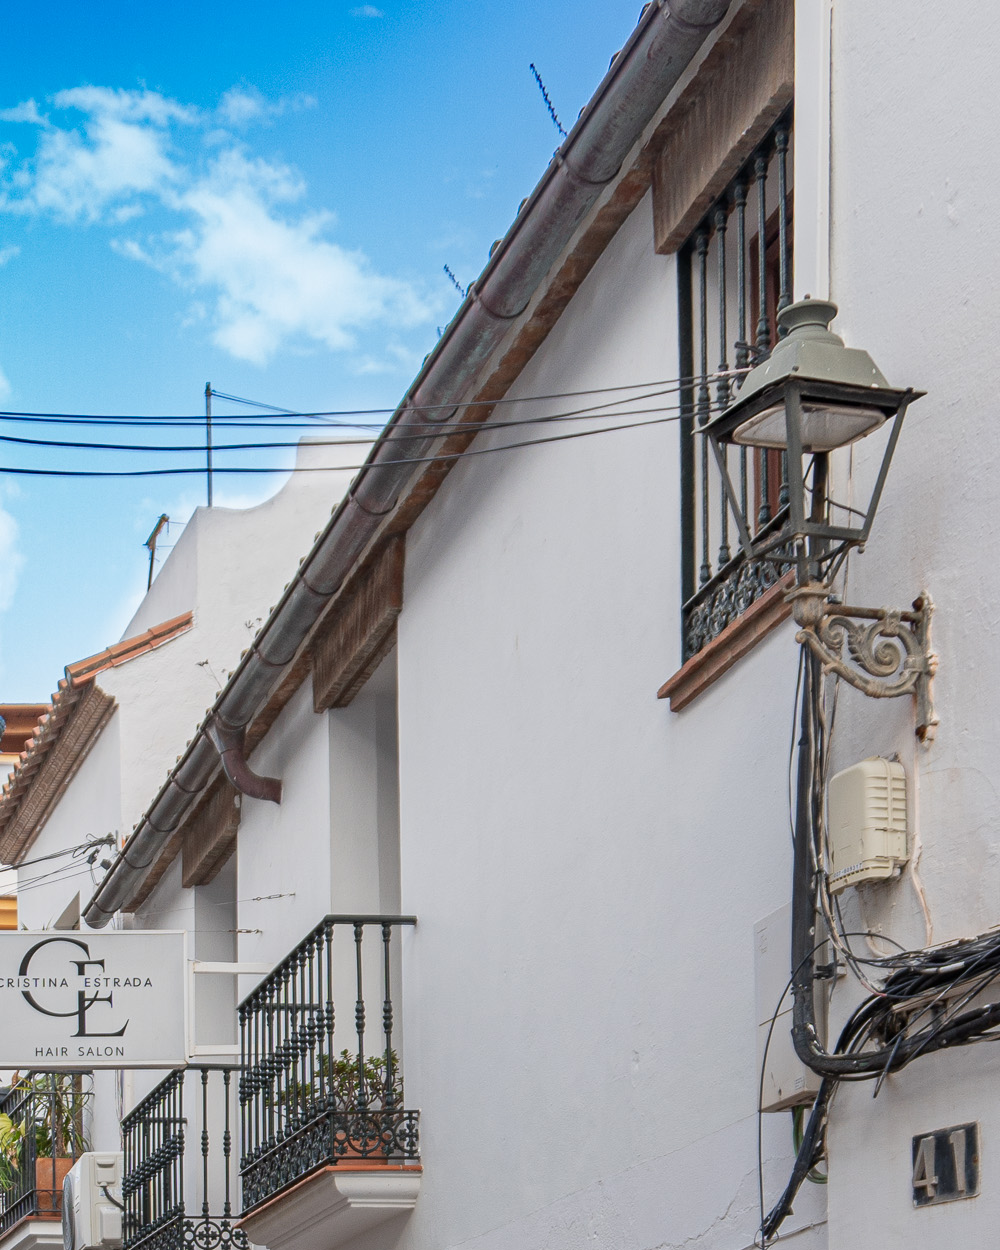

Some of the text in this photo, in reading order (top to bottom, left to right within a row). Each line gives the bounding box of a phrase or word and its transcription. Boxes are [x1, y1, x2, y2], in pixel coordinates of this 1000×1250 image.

[84, 976, 153, 988] ESTRADA
[35, 1046, 125, 1057] HAIR SALON
[913, 1129, 966, 1198] 41
